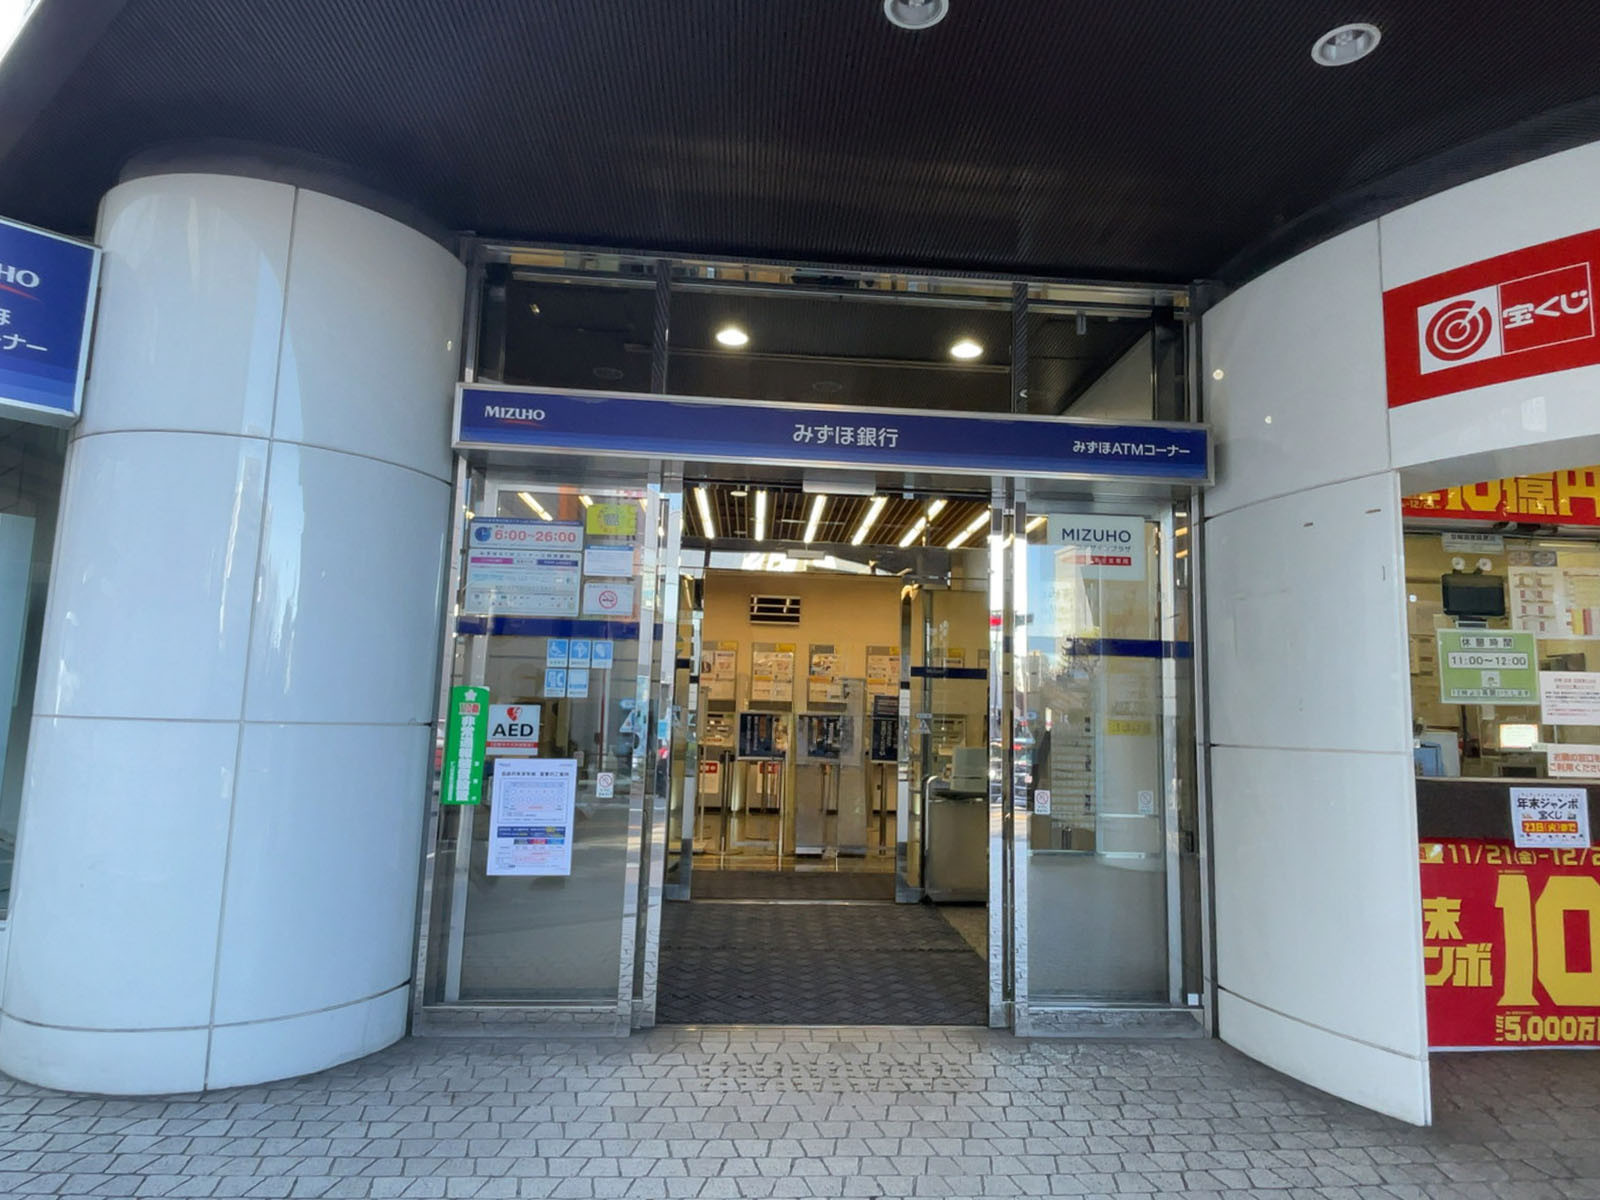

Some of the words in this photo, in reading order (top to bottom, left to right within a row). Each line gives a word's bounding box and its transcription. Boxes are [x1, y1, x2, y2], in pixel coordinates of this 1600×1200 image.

[1502, 289, 1590, 329] 宝くじ
[484, 405, 546, 421] MIZUHO
[793, 424, 899, 448] みずほ銀行
[1072, 440, 1191, 457] みずほATMコーナー
[1062, 528, 1131, 543] MIZUHO
[492, 723, 534, 737] AED
[1517, 797, 1579, 810] 年末ジャンボ
[1538, 810, 1563, 820] 宝くじ
